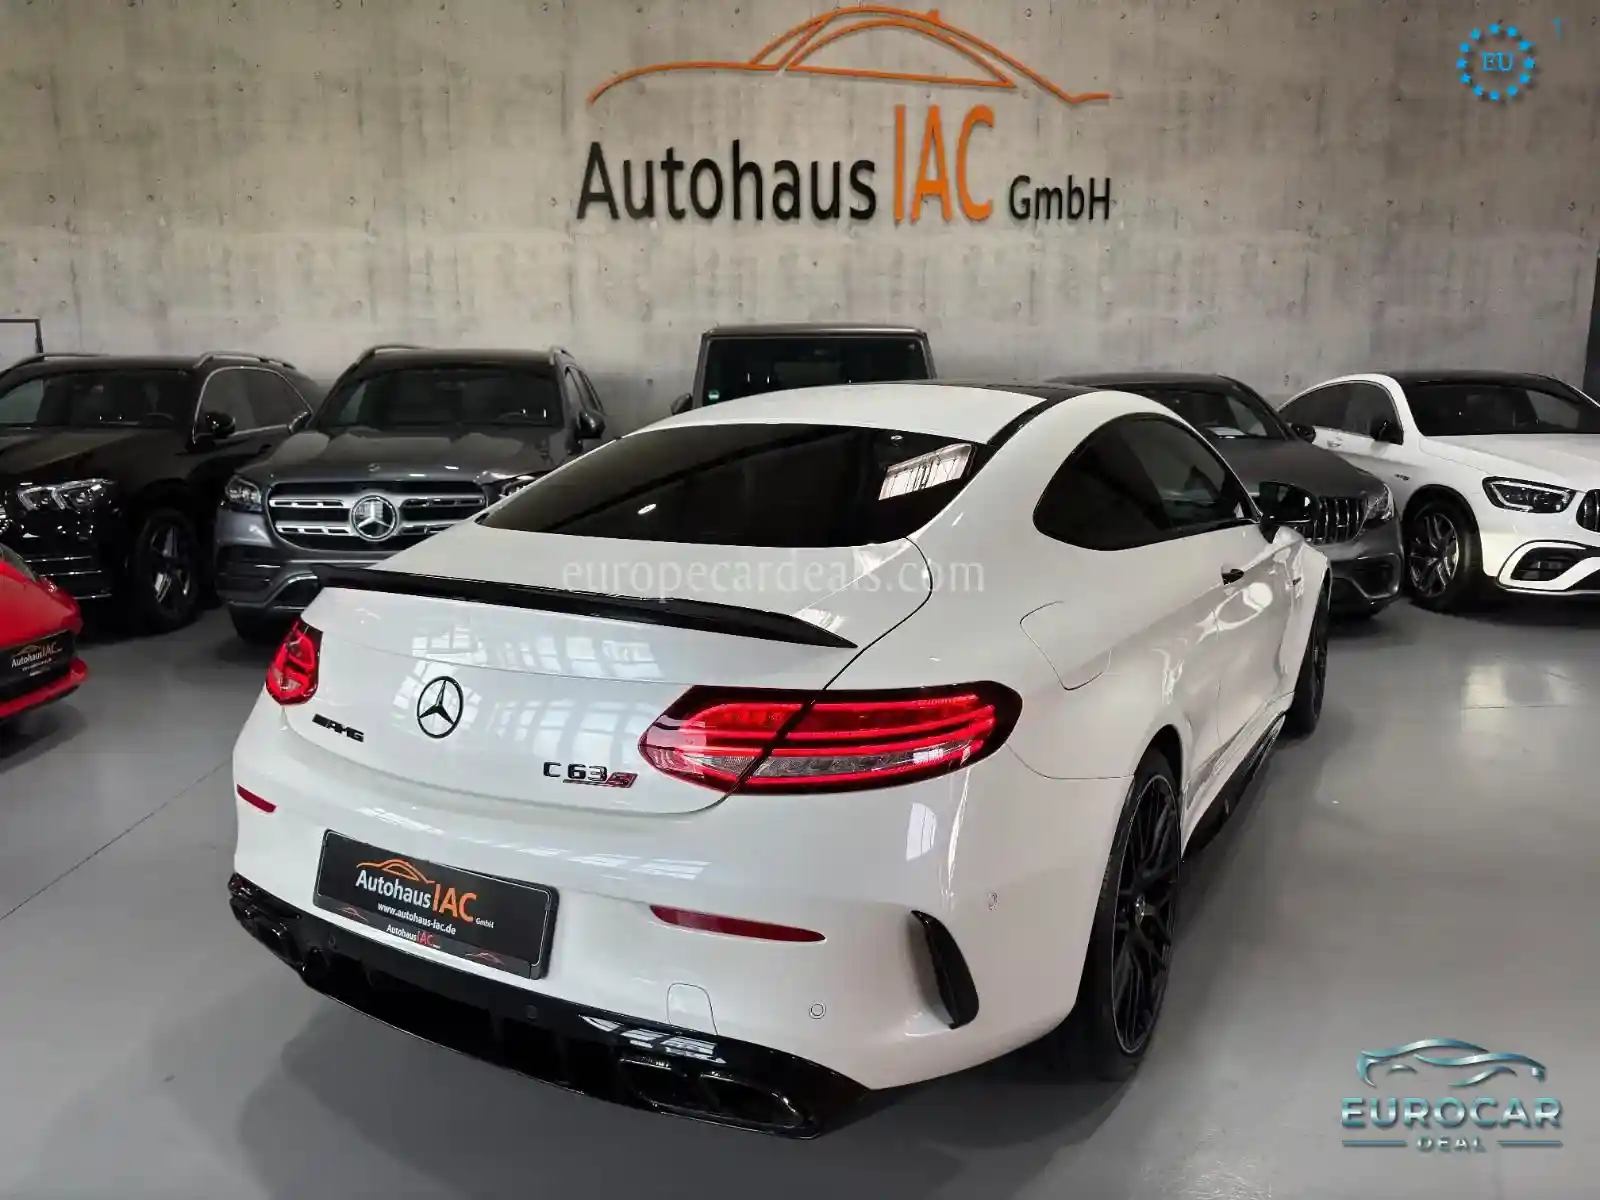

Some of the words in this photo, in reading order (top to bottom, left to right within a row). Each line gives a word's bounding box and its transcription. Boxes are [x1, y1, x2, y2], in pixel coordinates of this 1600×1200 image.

[576, 139, 877, 222] Autohaus
[893, 104, 995, 224] IAC
[1009, 175, 1112, 221] GmbH
[543, 762, 562, 777] C
[567, 764, 607, 782] 63
[355, 869, 432, 909] Autohaus
[432, 883, 477, 922] IAC
[475, 917, 495, 929] GmbH
[377, 902, 457, 935] www.autohaus-iac.de
[386, 924, 417, 942] Autohaus
